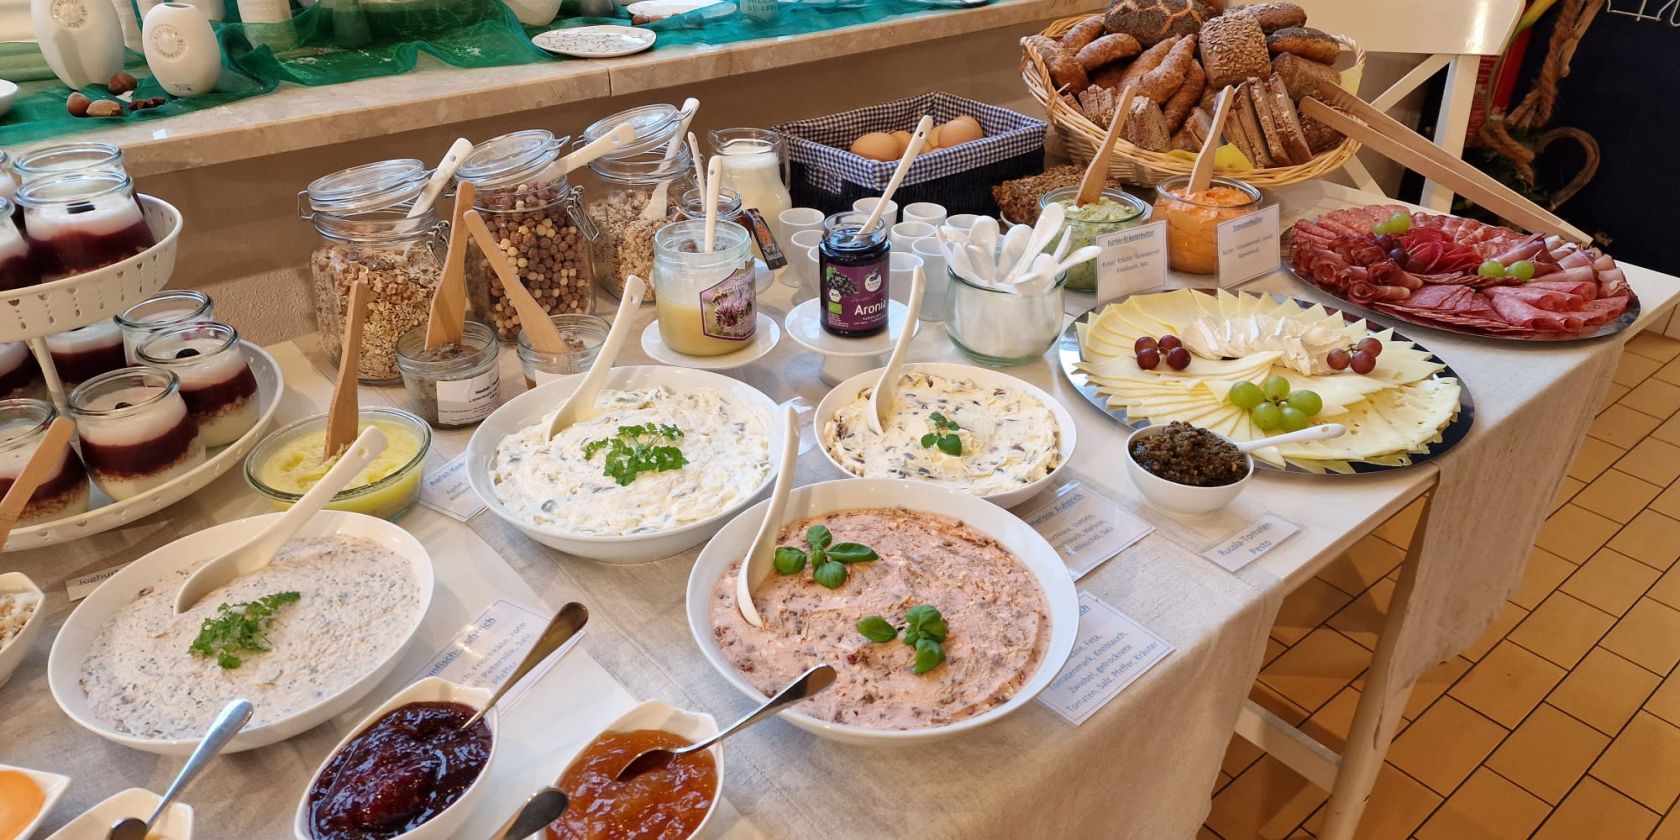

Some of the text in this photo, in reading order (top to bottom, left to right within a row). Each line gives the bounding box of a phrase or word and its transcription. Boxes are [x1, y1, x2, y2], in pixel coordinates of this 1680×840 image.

[854, 298, 887, 316] Aronia
[1216, 522, 1273, 556] Rucola-Tomaten
[1249, 540, 1272, 555] Pesto
